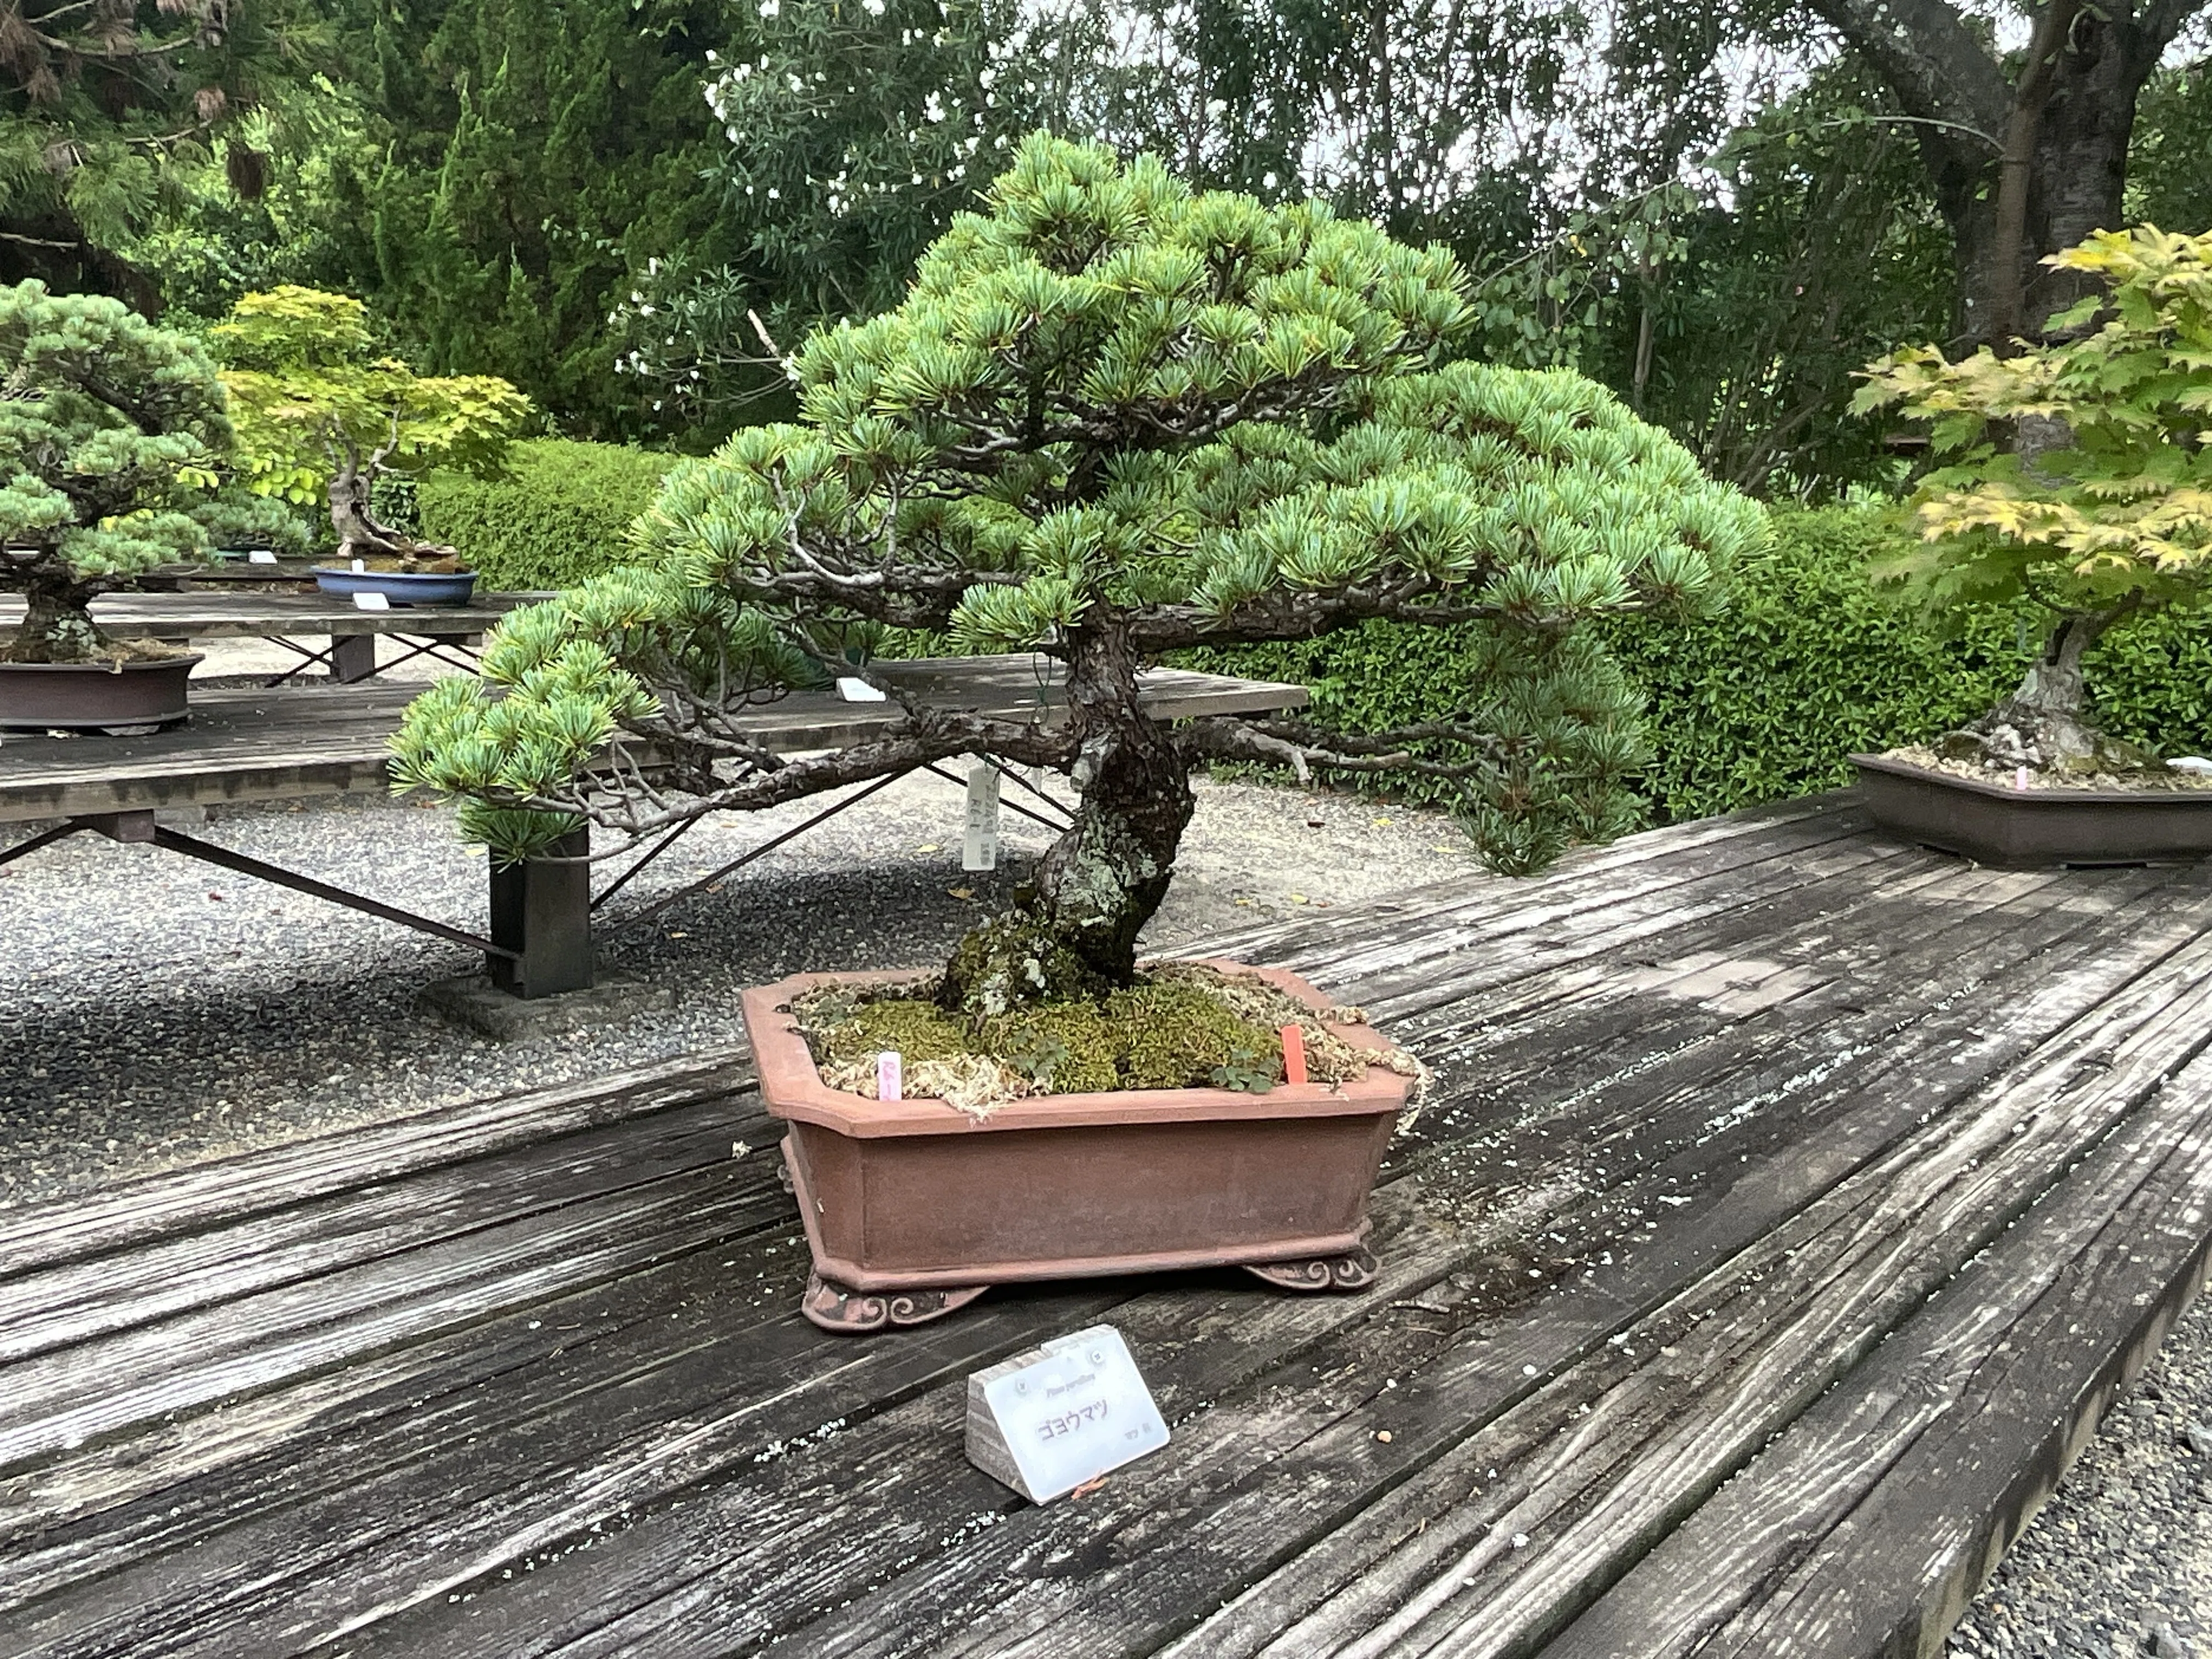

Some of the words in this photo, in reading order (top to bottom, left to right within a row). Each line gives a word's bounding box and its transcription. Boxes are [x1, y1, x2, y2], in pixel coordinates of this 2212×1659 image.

[1038, 1399, 1107, 1441] ゴヨウマツ
